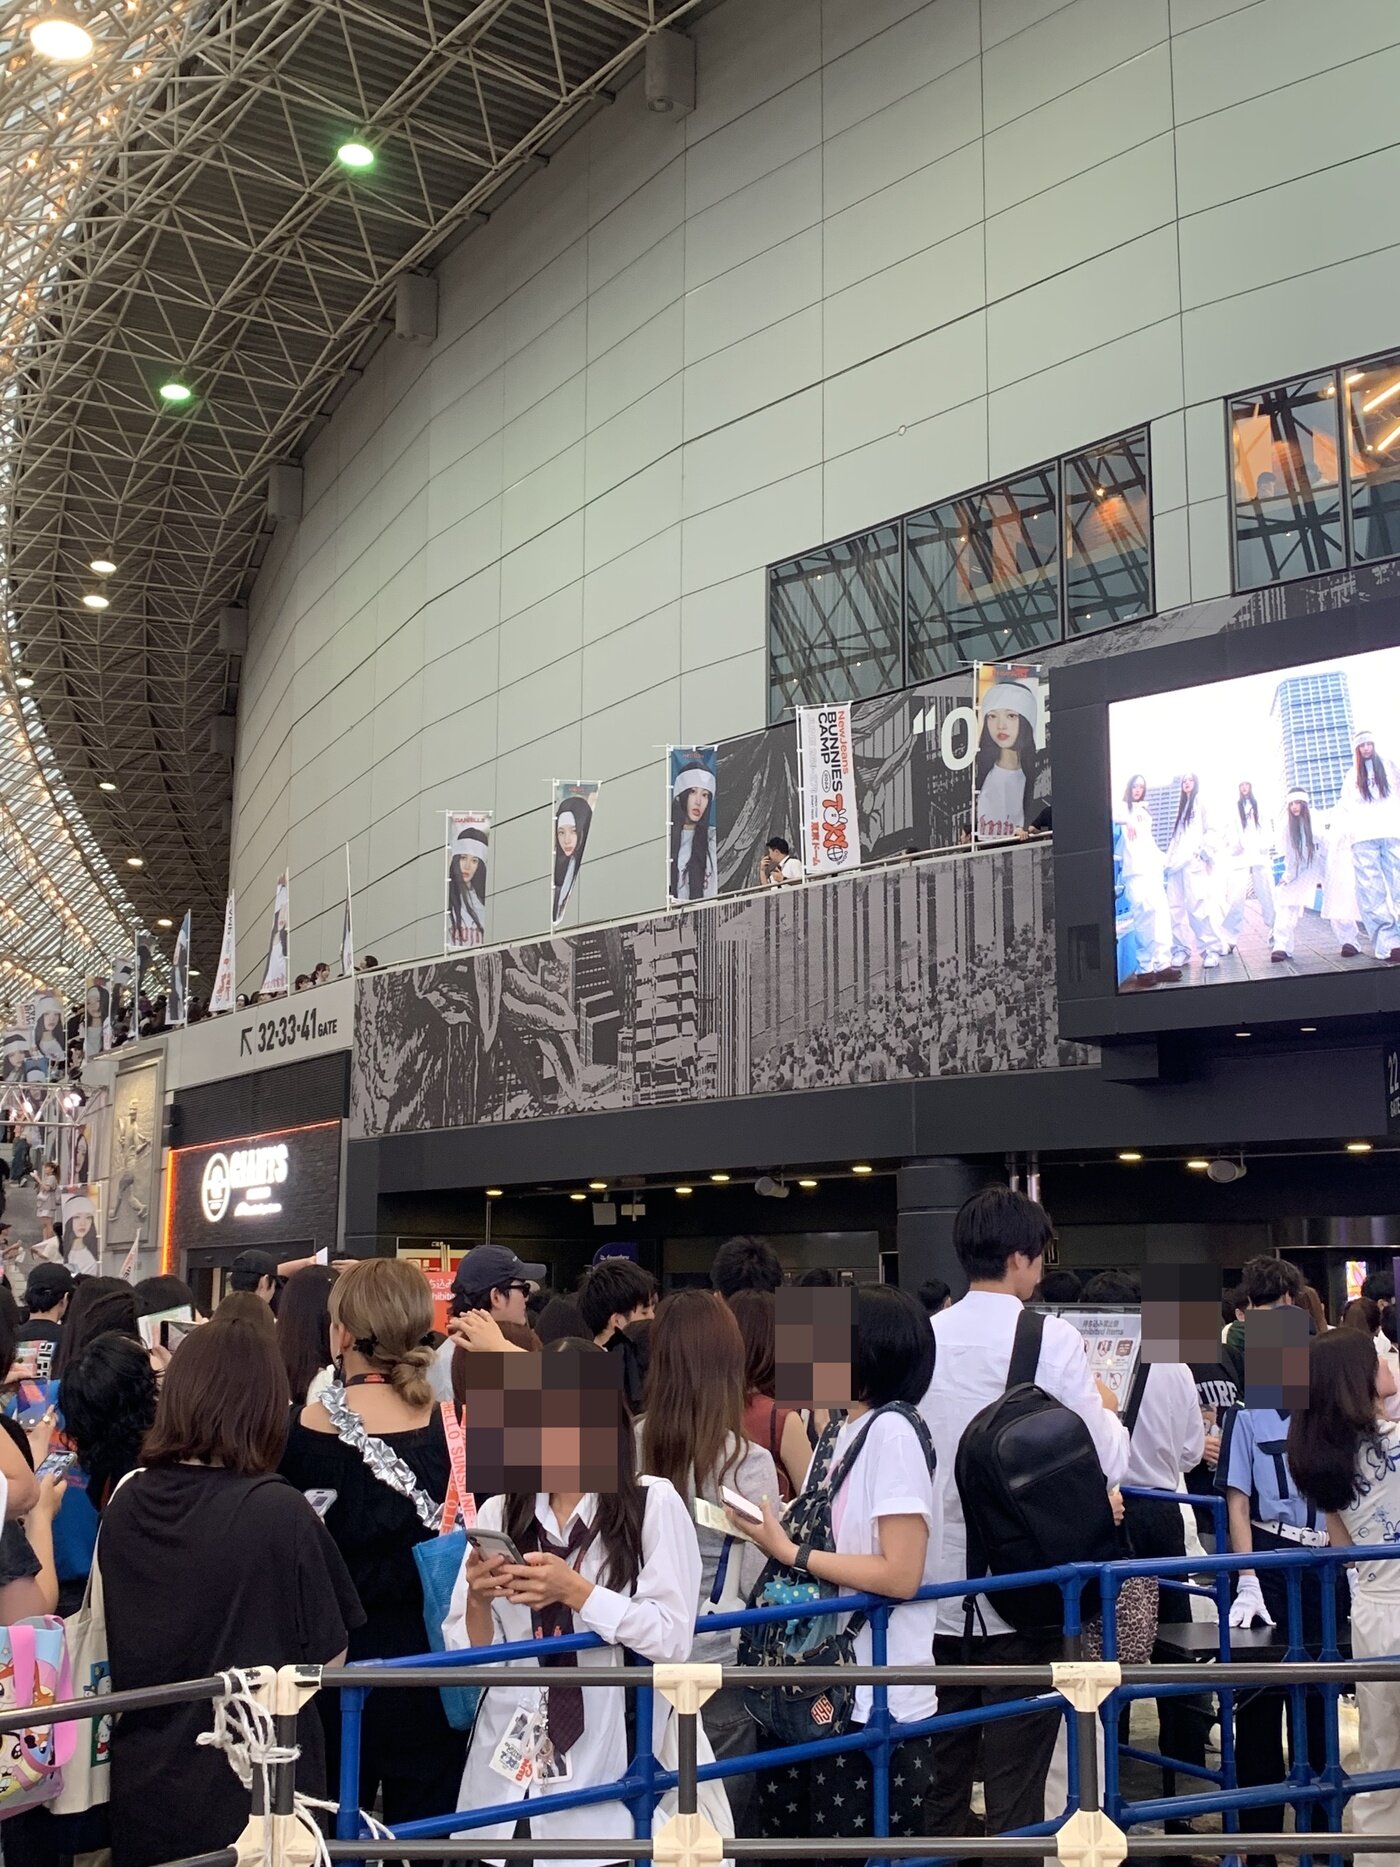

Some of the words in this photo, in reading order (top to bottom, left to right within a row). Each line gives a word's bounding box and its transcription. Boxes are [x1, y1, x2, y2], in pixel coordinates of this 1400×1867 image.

[818, 712, 830, 765] CAMP
[827, 711, 843, 792] BUNNIES
[837, 710, 849, 775] NewJeans
[318, 1019, 337, 1037] GATE
[442, 1402, 460, 1440] HELLO
